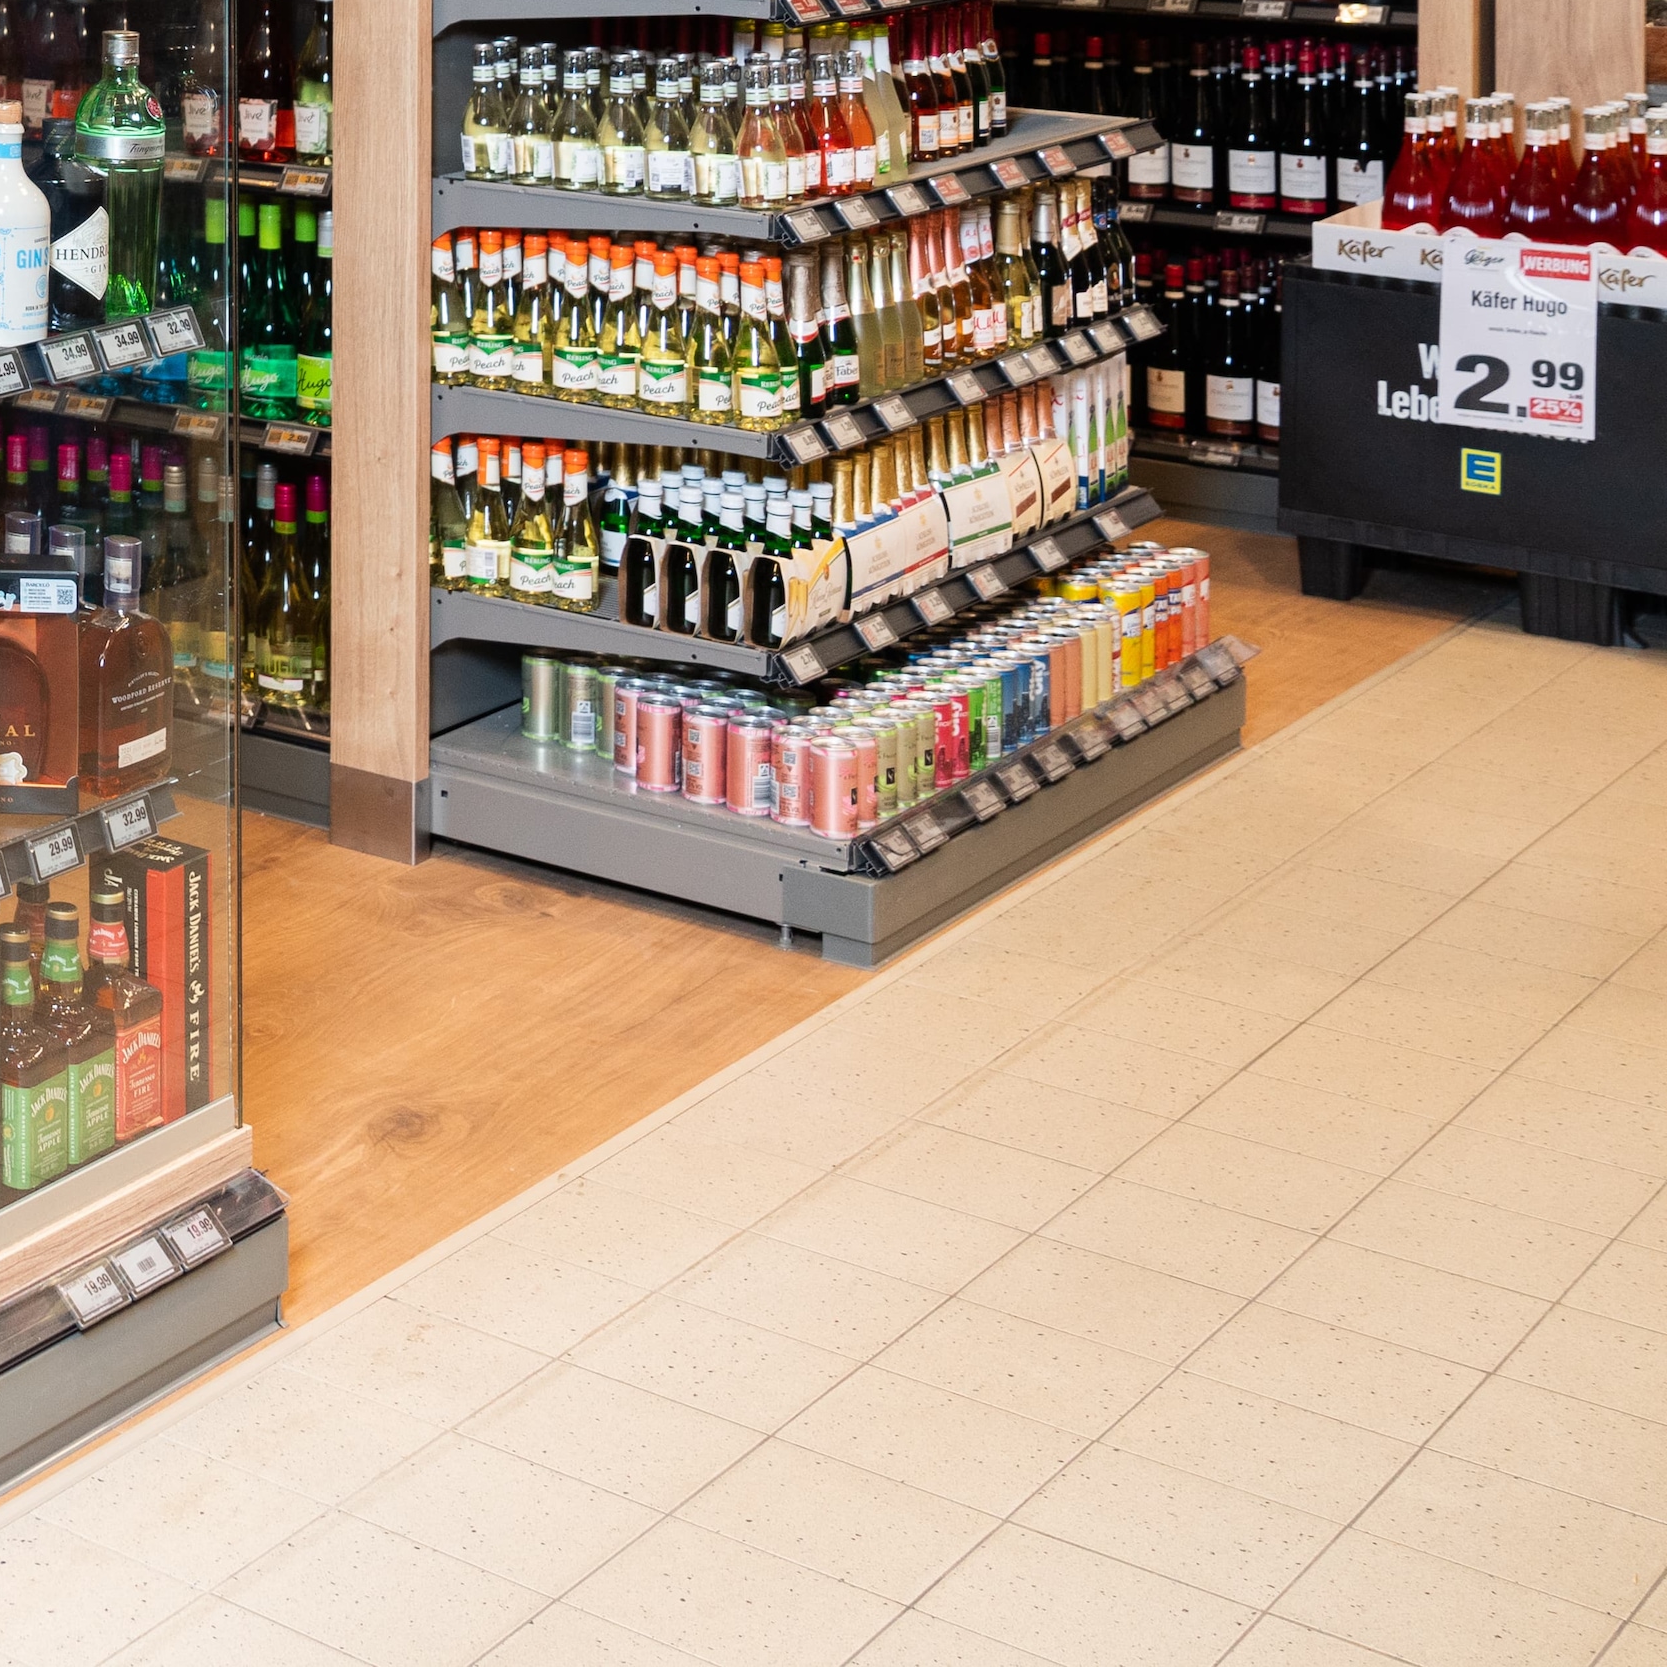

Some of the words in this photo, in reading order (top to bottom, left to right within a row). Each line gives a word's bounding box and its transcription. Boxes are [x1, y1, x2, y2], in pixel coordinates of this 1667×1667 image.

[17, 250, 40, 268] GIN
[1522, 252, 1589, 275] WERBUNG
[1472, 290, 1517, 310] Käfer
[1523, 295, 1567, 317] Hugo
[562, 372, 594, 383] Peach
[643, 383, 675, 394] Peach
[1533, 398, 1581, 418] 25%
[112, 688, 147, 704] WOODFORD
[148, 677, 171, 694] RESERVE
[49, 839, 73, 857] 29.99
[189, 871, 201, 908] JACK
[189, 911, 201, 974] DANIEL'S
[189, 1009, 199, 1083] FIRE
